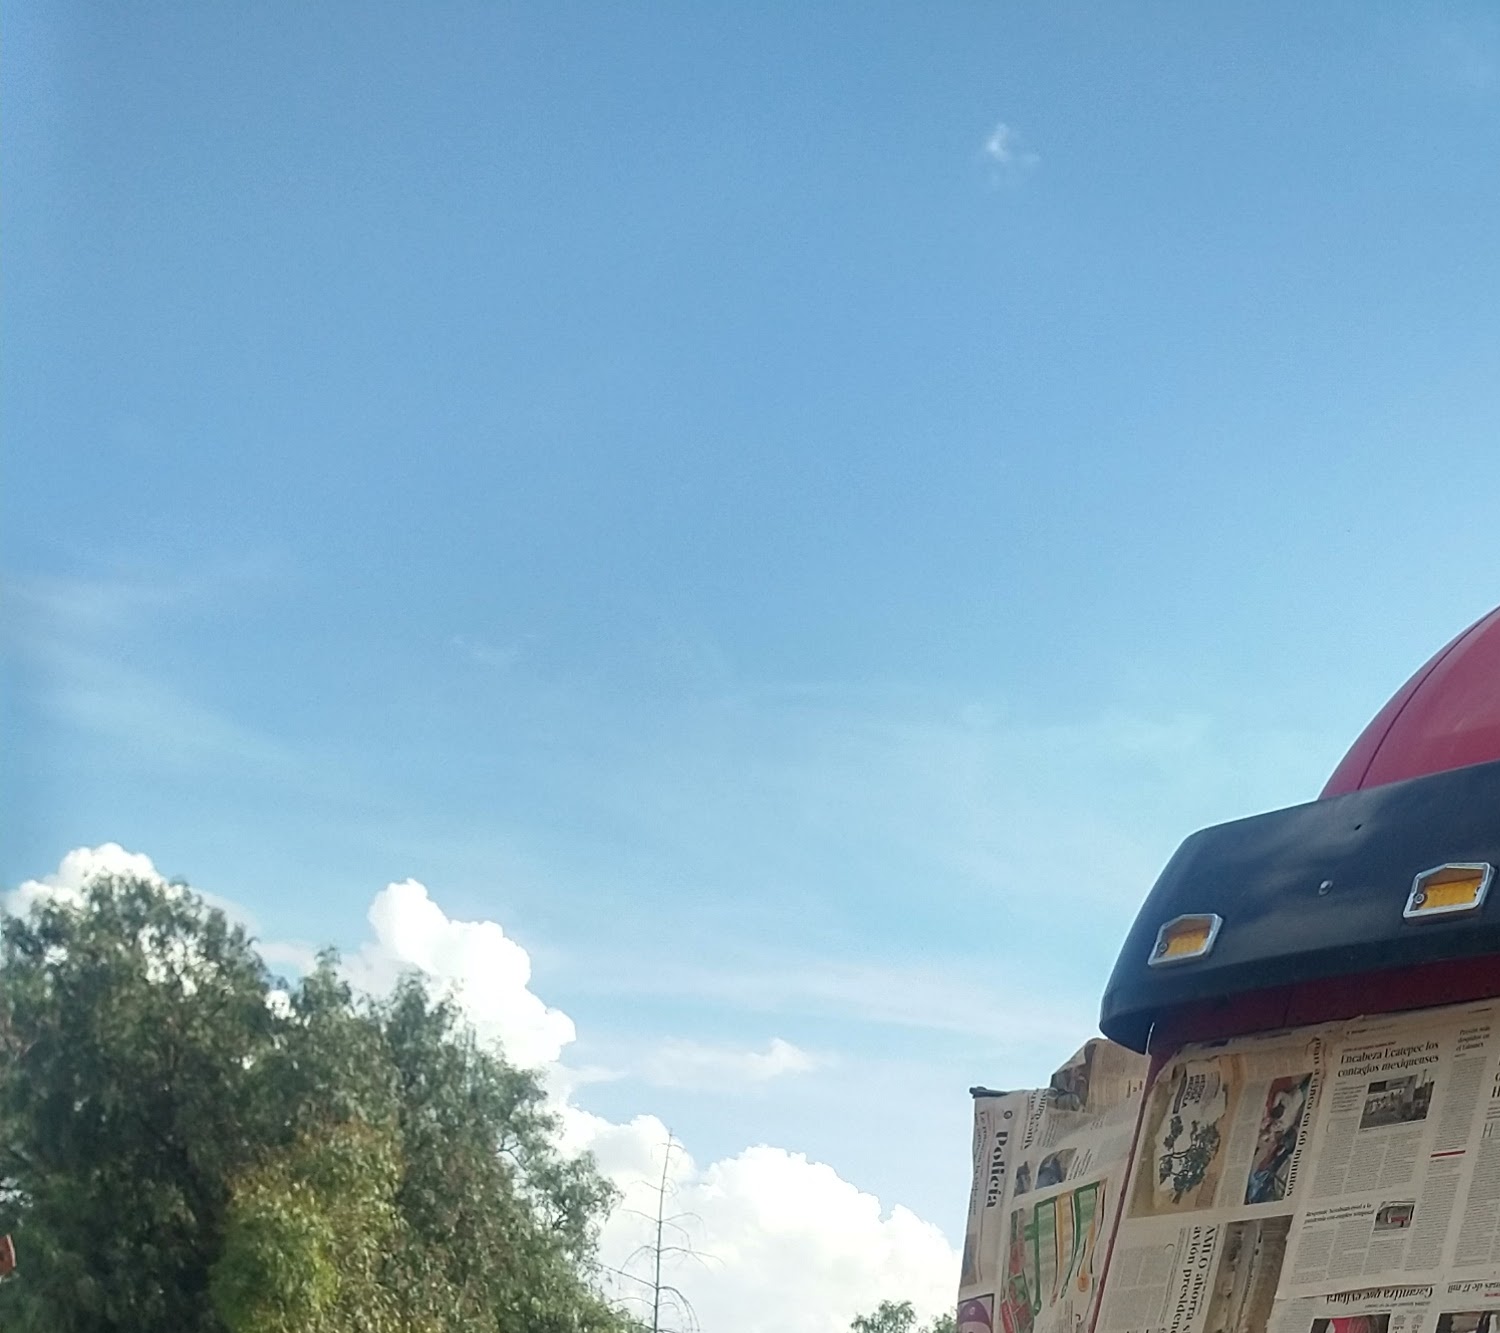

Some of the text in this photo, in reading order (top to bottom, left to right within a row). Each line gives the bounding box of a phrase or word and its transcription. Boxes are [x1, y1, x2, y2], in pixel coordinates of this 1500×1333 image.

[1337, 1054, 1439, 1078] contagios mexiquenses
[1340, 1040, 1439, 1064] Encabeza Ecatepec los
[1306, 1078, 1320, 1110] cinco
[1302, 1112, 1312, 1127] en
[1298, 1130, 1308, 1146] 60
[986, 1132, 1008, 1207] Policía
[1286, 1149, 1302, 1196] minutos
[1187, 1226, 1202, 1264] avión
[1198, 1224, 1216, 1269] AMLO
[1186, 1273, 1204, 1320] ahorra
[1326, 1287, 1434, 1304] Garantiza que evitará
[1472, 1283, 1484, 1291] de
